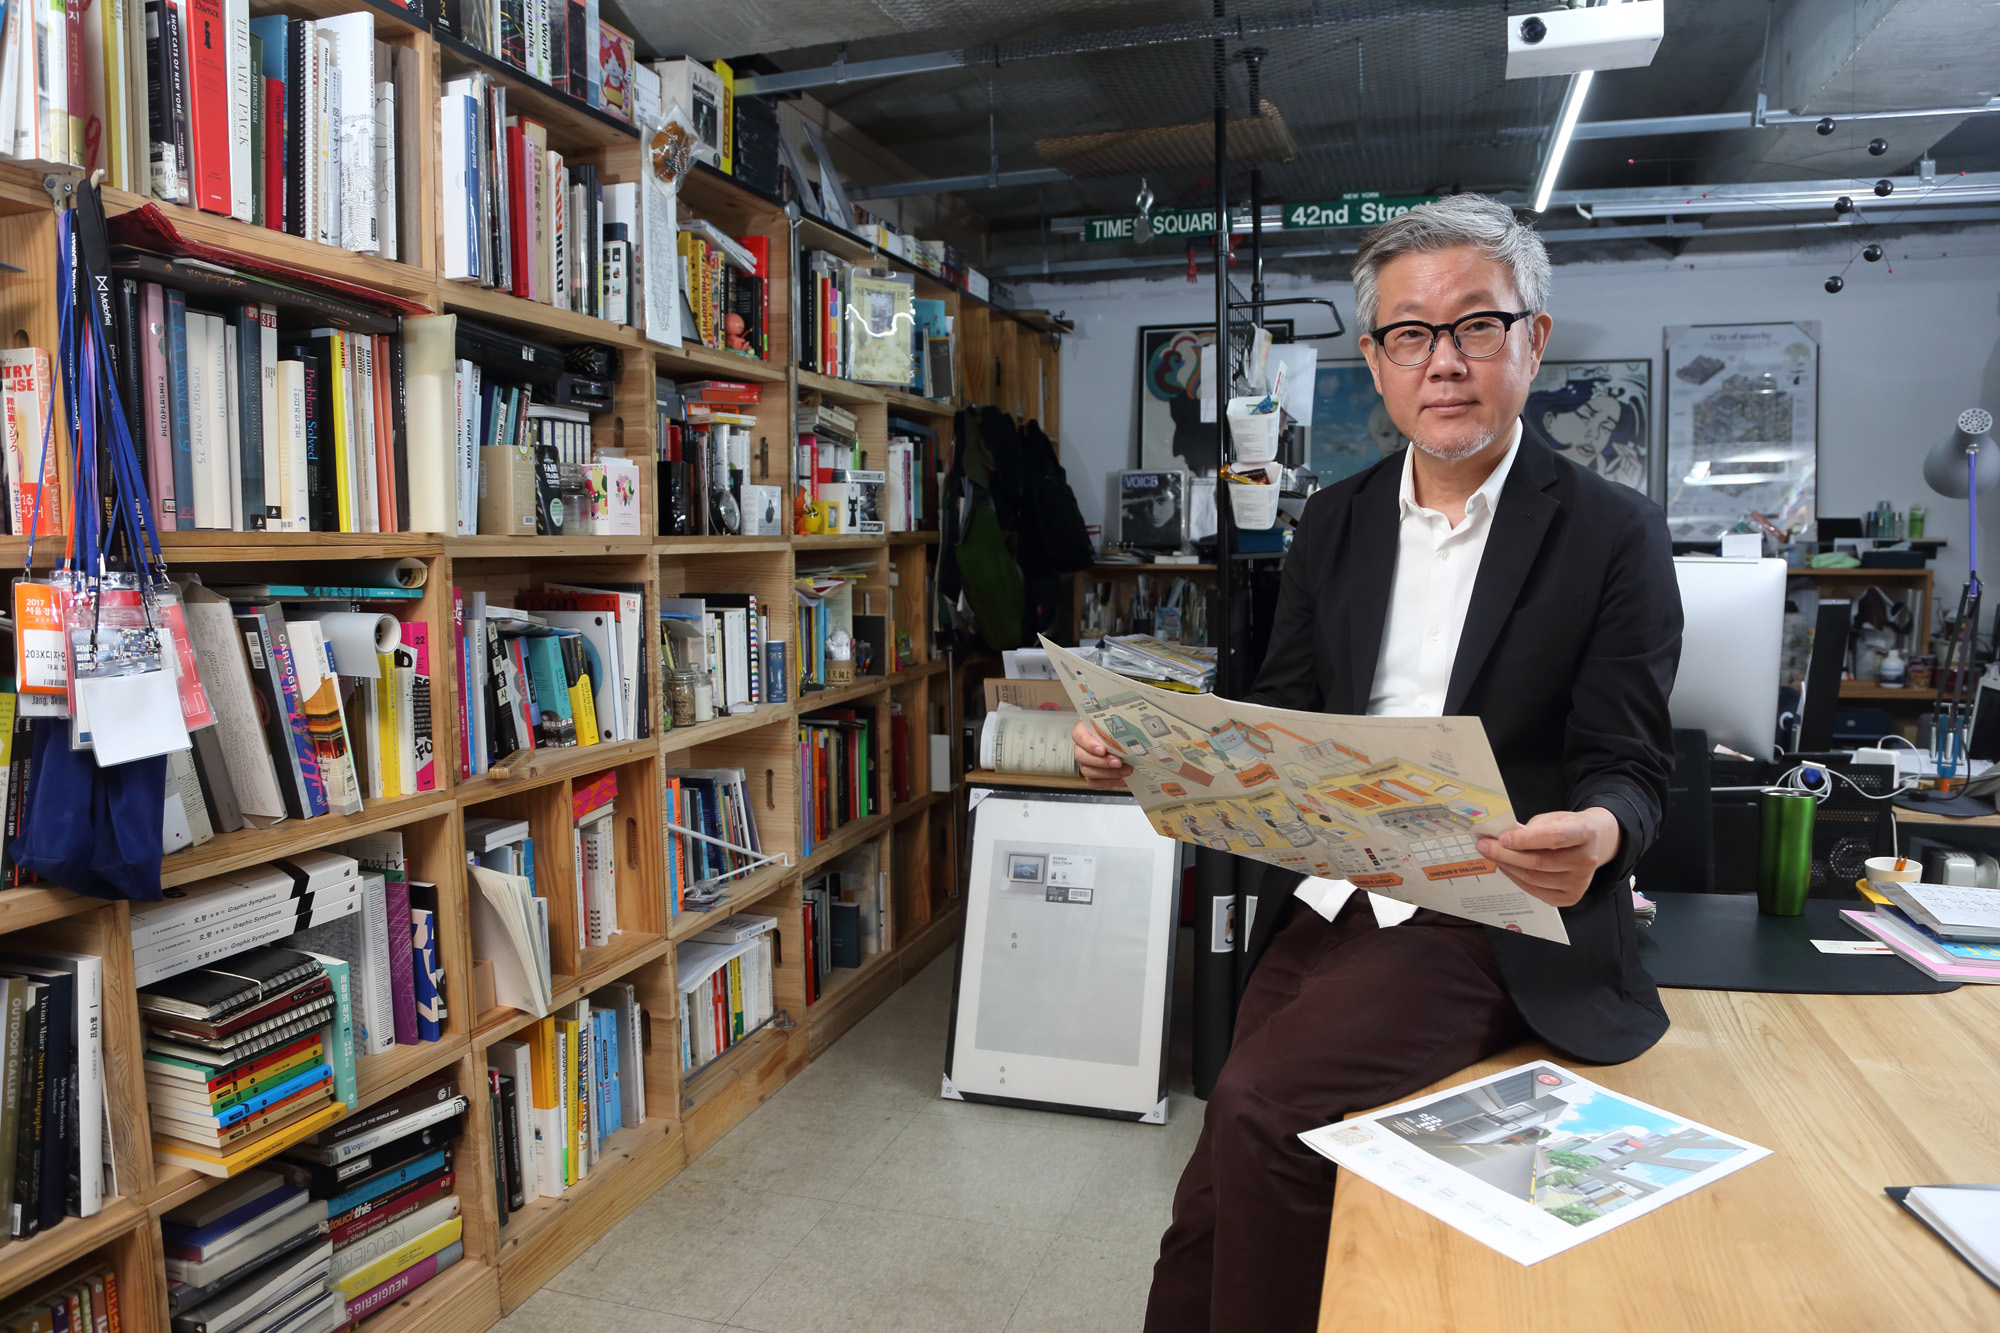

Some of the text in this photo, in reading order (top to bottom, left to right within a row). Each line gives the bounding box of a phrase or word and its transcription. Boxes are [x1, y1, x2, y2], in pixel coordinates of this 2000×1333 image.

[173, 59, 179, 70] OF
[237, 19, 248, 146] THE ART PACK
[1291, 202, 1431, 225] 42nd Stre
[1092, 212, 1217, 239] TIME SQUAR
[100, 293, 112, 326] Malofiej
[261, 313, 277, 329] SPD
[175, 358, 189, 434] ANNUAL
[158, 382, 168, 438] PICTOPLASMA
[193, 367, 206, 464] DESIGN PARK 25
[305, 368, 318, 460] Problem Solved
[180, 440, 190, 452] 9
[1125, 475, 1158, 488] VOICE
[415, 636, 425, 645] 22
[32, 696, 49, 706] Jang,
[1429, 869, 1453, 878] BINDING
[1459, 865, 1487, 874] PRINTING
[227, 893, 277, 913] Graphic Symphonia
[232, 909, 281, 929] Graphic Symphonia
[230, 928, 280, 949] Graphic Symphonia
[6, 998, 22, 1109] OUTDOOR GALLERY
[33, 995, 49, 1141] Vivian Maier Street Photographer
[335, 1128, 345, 1137] LOGO
[345, 1123, 362, 1135] DESIGN
[368, 1117, 376, 1126] THE
[376, 1112, 389, 1123] WORLD
[510, 1106, 518, 1137] Information
[351, 1135, 380, 1151] logolounge
[400, 1170, 406, 1182] 9
[354, 1202, 372, 1219] this
[334, 1238, 349, 1250] New
[351, 1231, 366, 1246] Shop
[367, 1223, 386, 1240] Image
[388, 1211, 413, 1231] Graphics
[354, 1276, 408, 1316] NEUGIERIG
